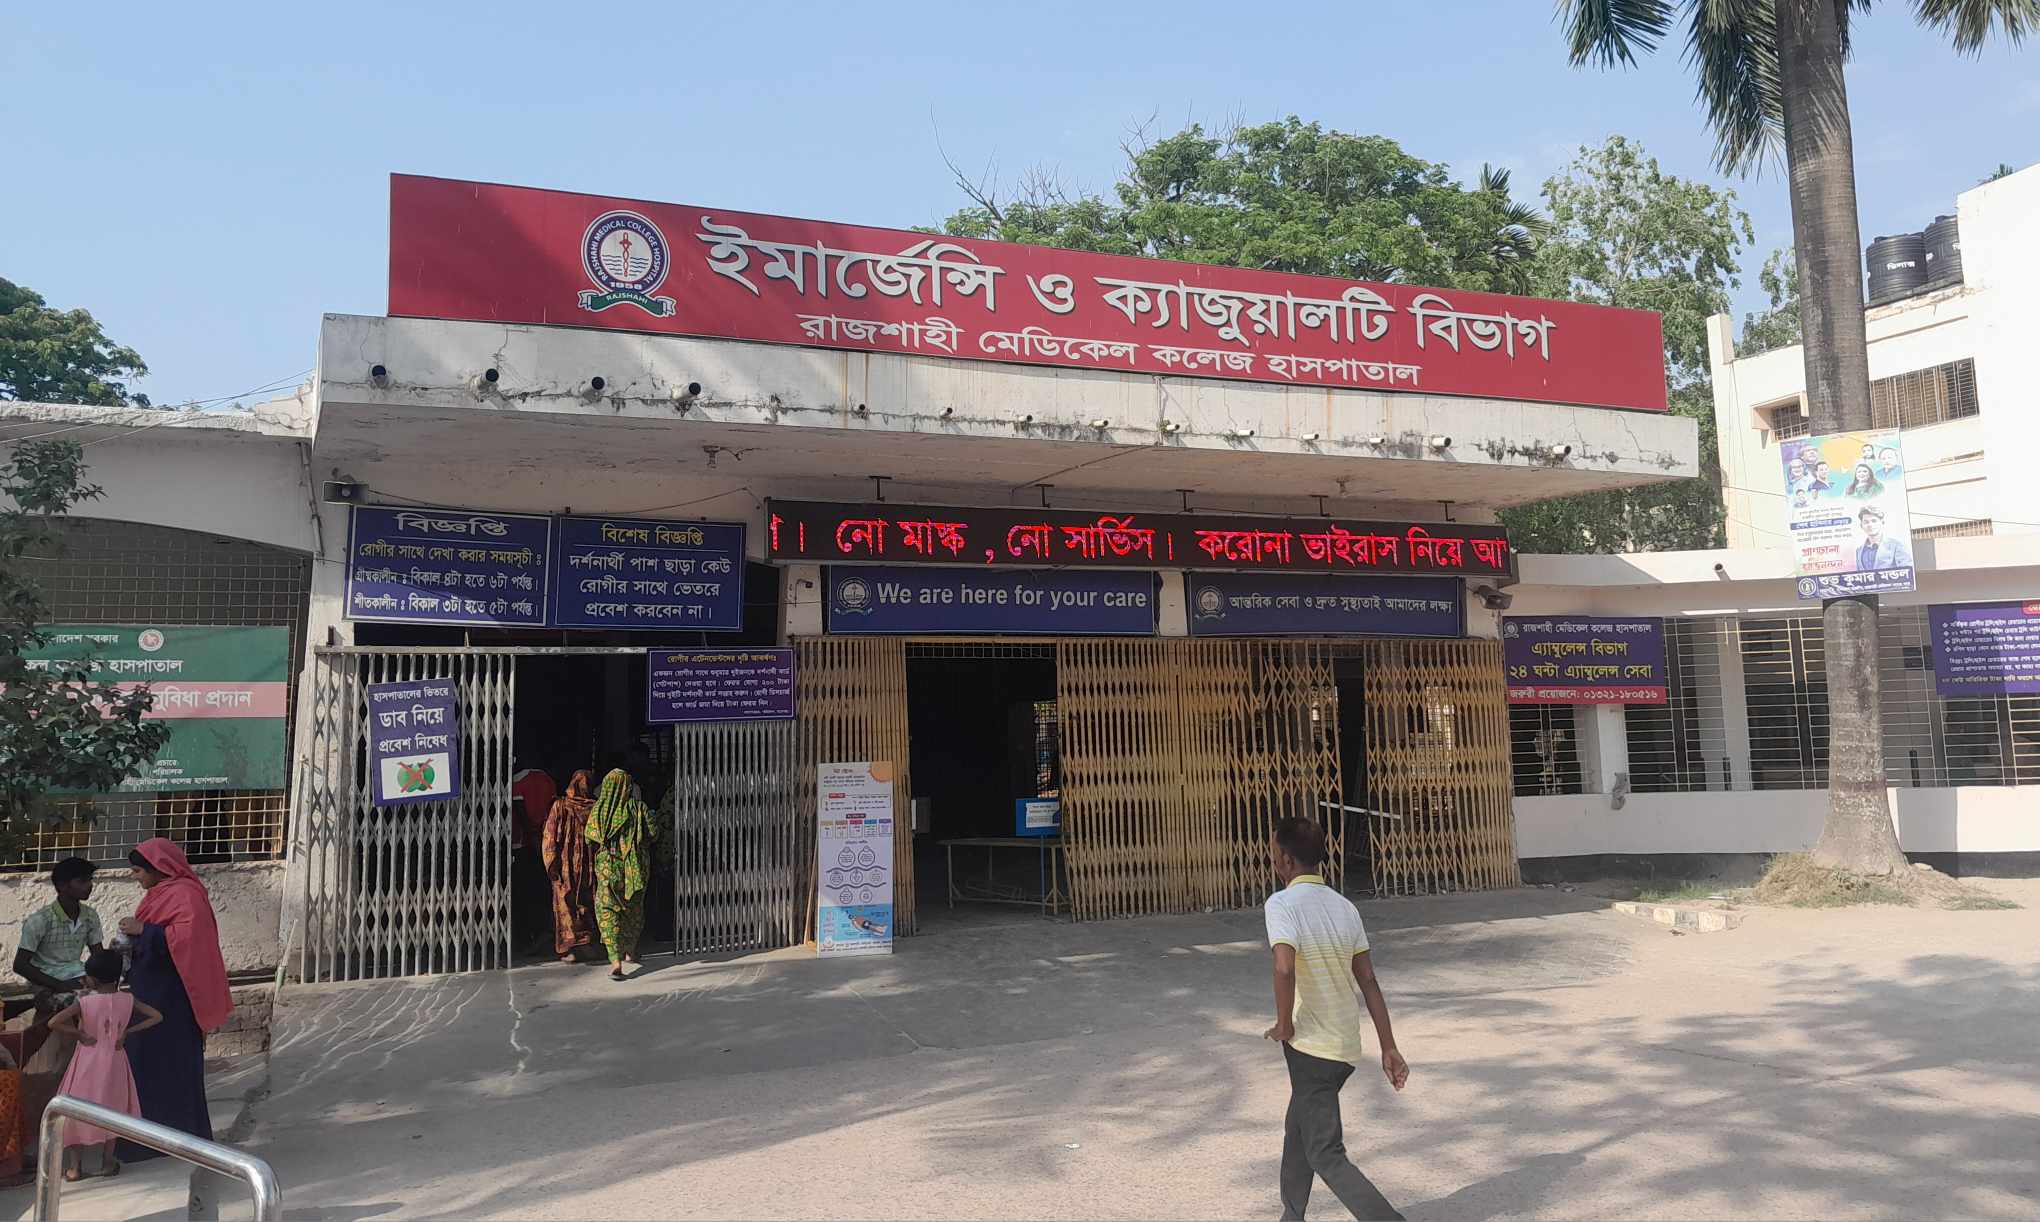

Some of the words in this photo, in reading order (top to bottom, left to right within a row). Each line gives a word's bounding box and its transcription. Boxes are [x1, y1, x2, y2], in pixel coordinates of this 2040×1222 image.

[594, 220, 626, 242] MEDICAL
[627, 220, 658, 248] COLLEGE
[647, 247, 661, 284] HOSPITAL
[606, 293, 648, 304] RAJSHAHI
[696, 215, 1004, 313] ইমার্জেন্সি
[1027, 273, 1075, 315] ও
[1095, 276, 1396, 347] ক্যাজুয়ালটি
[1409, 292, 1556, 361] বিভাগ
[795, 313, 966, 354] রাজশাহী
[978, 326, 1138, 366] মেডিকেল
[1149, 344, 1261, 375] কলেজ
[1267, 353, 1422, 387] হাসপাতাল
[392, 512, 512, 537] বিজ্ঞপ্তি
[601, 522, 649, 544] বিশেষ
[655, 525, 705, 546] বিজ্ঞপ্তি
[360, 539, 396, 558] রোগীর
[399, 545, 425, 560] সাথে
[429, 547, 454, 561] দেখা
[458, 548, 487, 563] করার
[489, 548, 533, 569] সময়সূচী
[836, 518, 888, 556] নো
[897, 519, 968, 557] মাস্ক
[1007, 521, 1053, 559] নো
[1060, 515, 1155, 560] সার্ভিস
[1195, 529, 1293, 564] করোনা
[1299, 524, 1400, 569] ভাইরাস
[1405, 526, 1464, 568] নিয়ে
[568, 551, 625, 573] দর্শনার্থী
[630, 556, 659, 573] পাশ
[664, 557, 697, 576] ছাড়া
[701, 556, 732, 575] কেউ
[410, 566, 441, 586] বিকাল
[443, 568, 461, 587] ৪টা
[464, 573, 487, 588] হতে
[489, 571, 508, 590] ৬টা
[580, 575, 629, 595] রোগীর
[633, 580, 668, 597] সাথে
[674, 582, 721, 598] ভেতরে
[354, 592, 398, 611] শীতকালীন
[408, 592, 441, 614] বিকাল
[442, 594, 462, 614] ৩টা
[464, 599, 487, 614] হতে
[489, 597, 508, 616] ৫টা
[877, 583, 912, 604] We
[919, 588, 953, 604] are
[961, 584, 1008, 605] here
[1014, 584, 1044, 606] for
[1050, 589, 1097, 610] your
[1103, 591, 1147, 608] care
[1229, 593, 1272, 608] আন্তরিক
[1276, 596, 1299, 609] সেবা
[1304, 596, 1313, 608] ও
[1315, 596, 1337, 610] দ্রুত
[1384, 598, 1427, 612] আমাদের
[585, 602, 629, 619] প্রবেশ
[633, 604, 683, 620] করবেন
[1522, 621, 1553, 634] রাজশাহী
[1556, 621, 1588, 634] মেডিকেল
[1590, 623, 1613, 634] কলেজ
[1615, 623, 1652, 635] হাসপাতাল
[1590, 638, 1629, 656] বিভাগ
[107, 658, 184, 674] হাসপাতাল
[1510, 664, 1528, 679] ২৪
[1532, 661, 1560, 680] ঘন্টা
[1624, 664, 1653, 679] সেবা
[205, 687, 254, 708] প্রদান
[373, 689, 421, 702] হাসপাতালের
[424, 686, 449, 698] ভিতরে
[378, 710, 408, 728] ডাব
[410, 703, 445, 727] নিয়ে
[378, 737, 411, 753] প্রবেশ
[415, 732, 449, 750] নিষেধ
